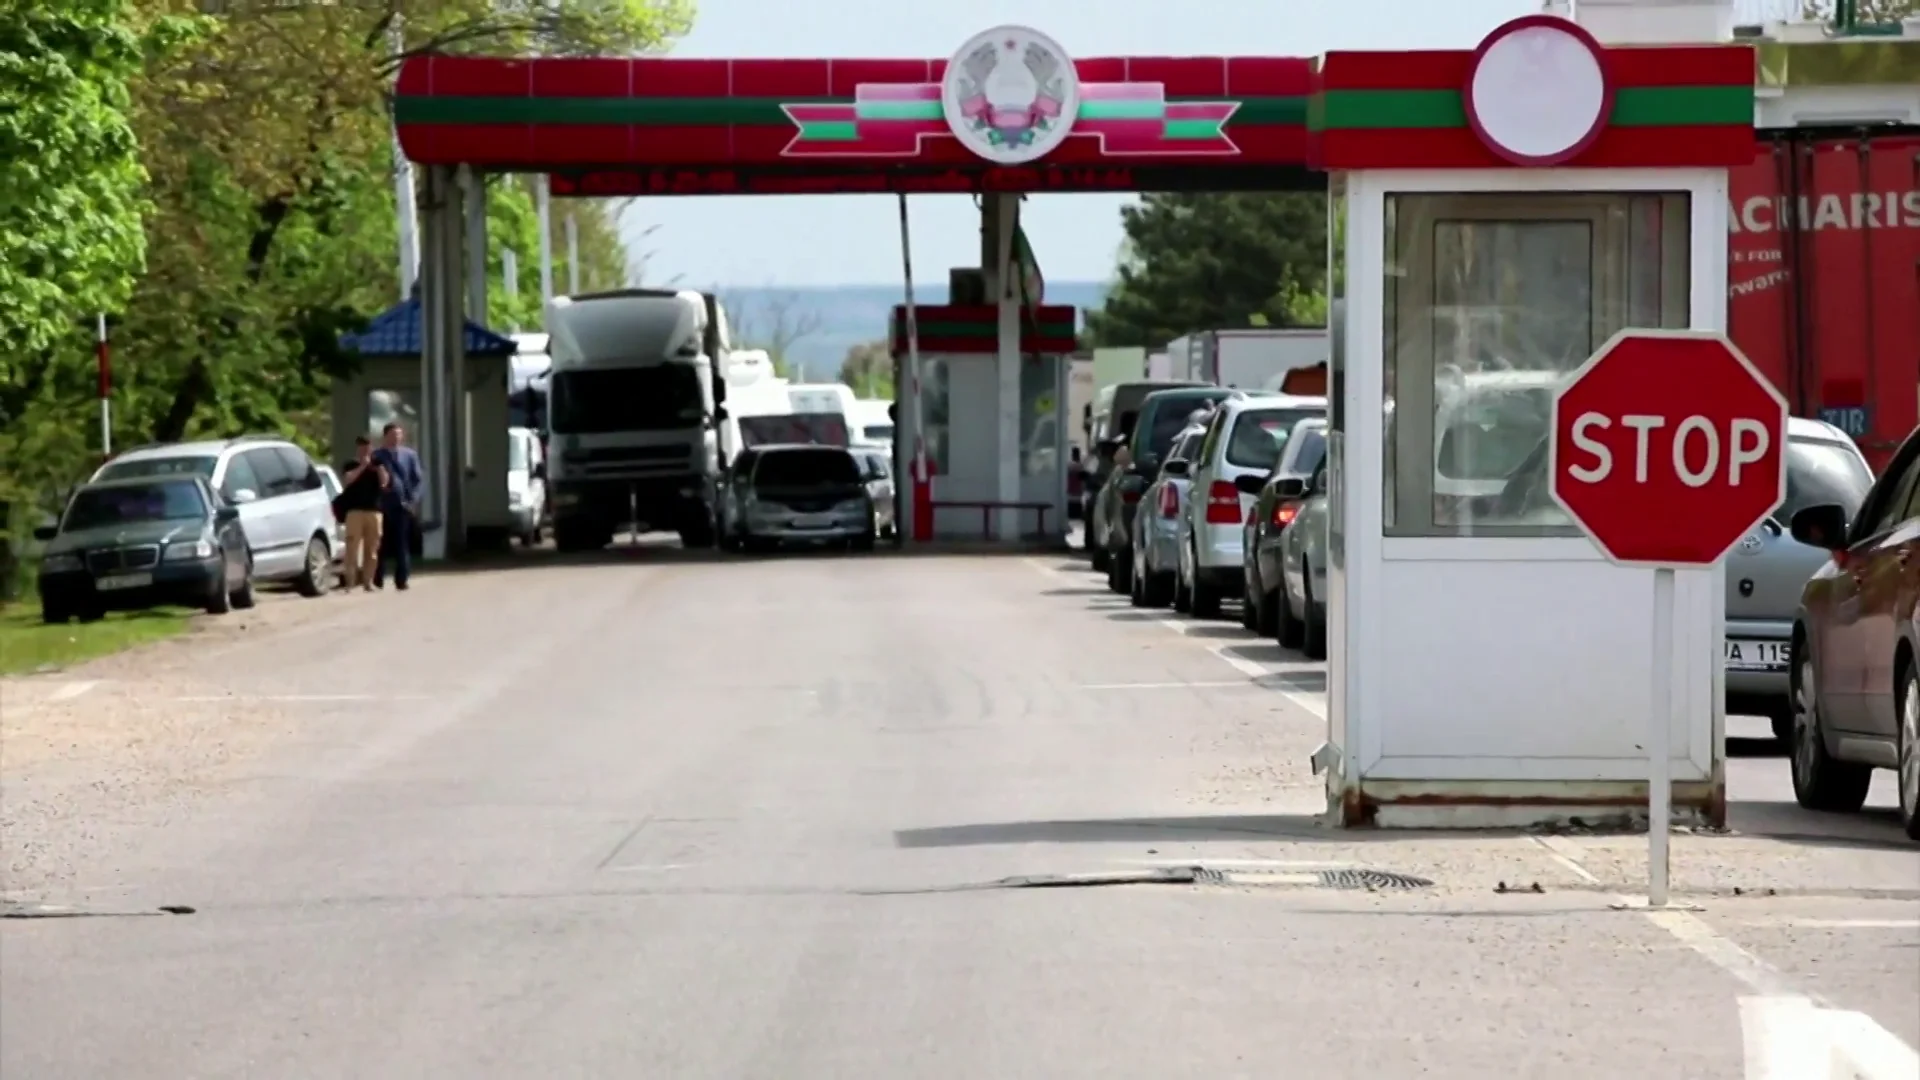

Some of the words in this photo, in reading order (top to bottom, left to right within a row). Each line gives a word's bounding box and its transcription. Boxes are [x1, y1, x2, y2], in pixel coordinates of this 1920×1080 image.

[1823, 408, 1865, 436] TIR
[1568, 411, 1770, 488] STOP
[1725, 641, 1743, 660] A
